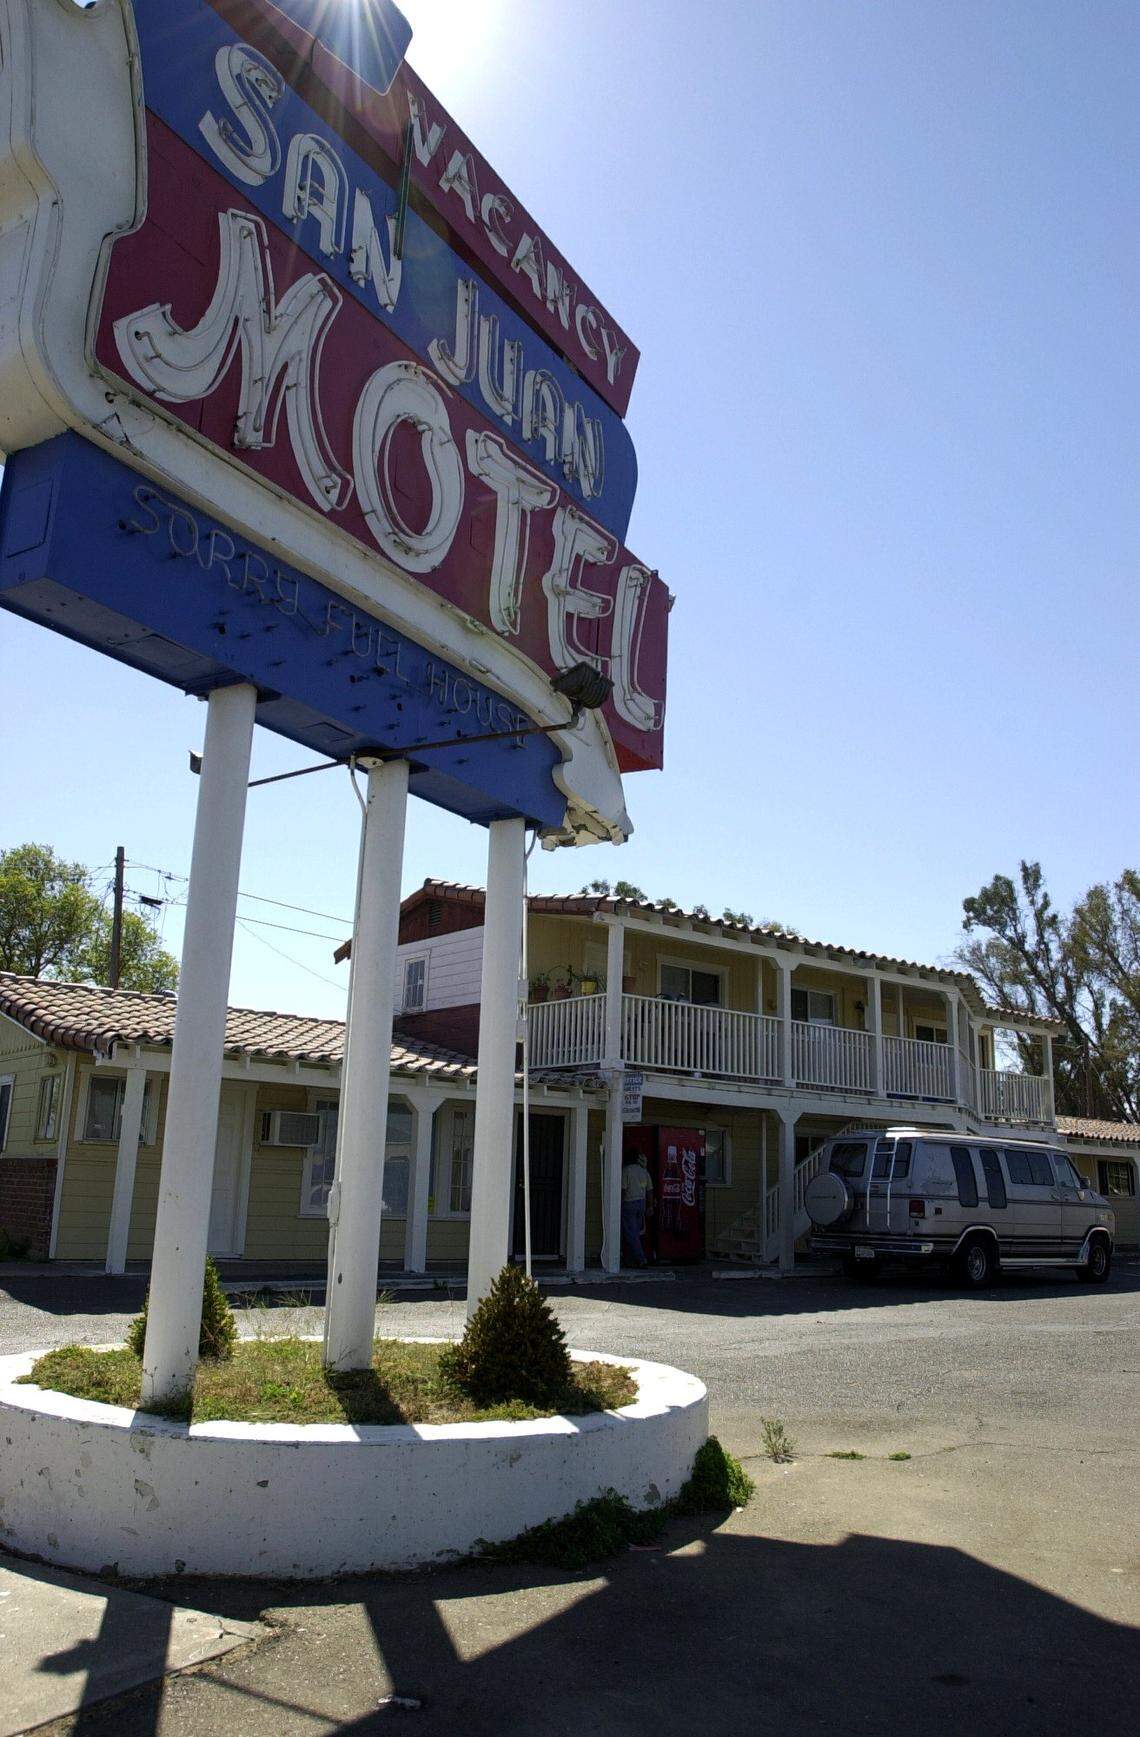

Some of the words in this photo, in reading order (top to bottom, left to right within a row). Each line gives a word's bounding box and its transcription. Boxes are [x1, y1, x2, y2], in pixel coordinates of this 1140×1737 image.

[198, 42, 402, 314] SAN
[427, 277, 605, 500] JUAN
[405, 90, 627, 385] VACANCY
[112, 208, 666, 732] MOTEL
[130, 484, 299, 616] SORRY
[324, 599, 413, 686] FULL
[426, 662, 529, 749] HOUSE
